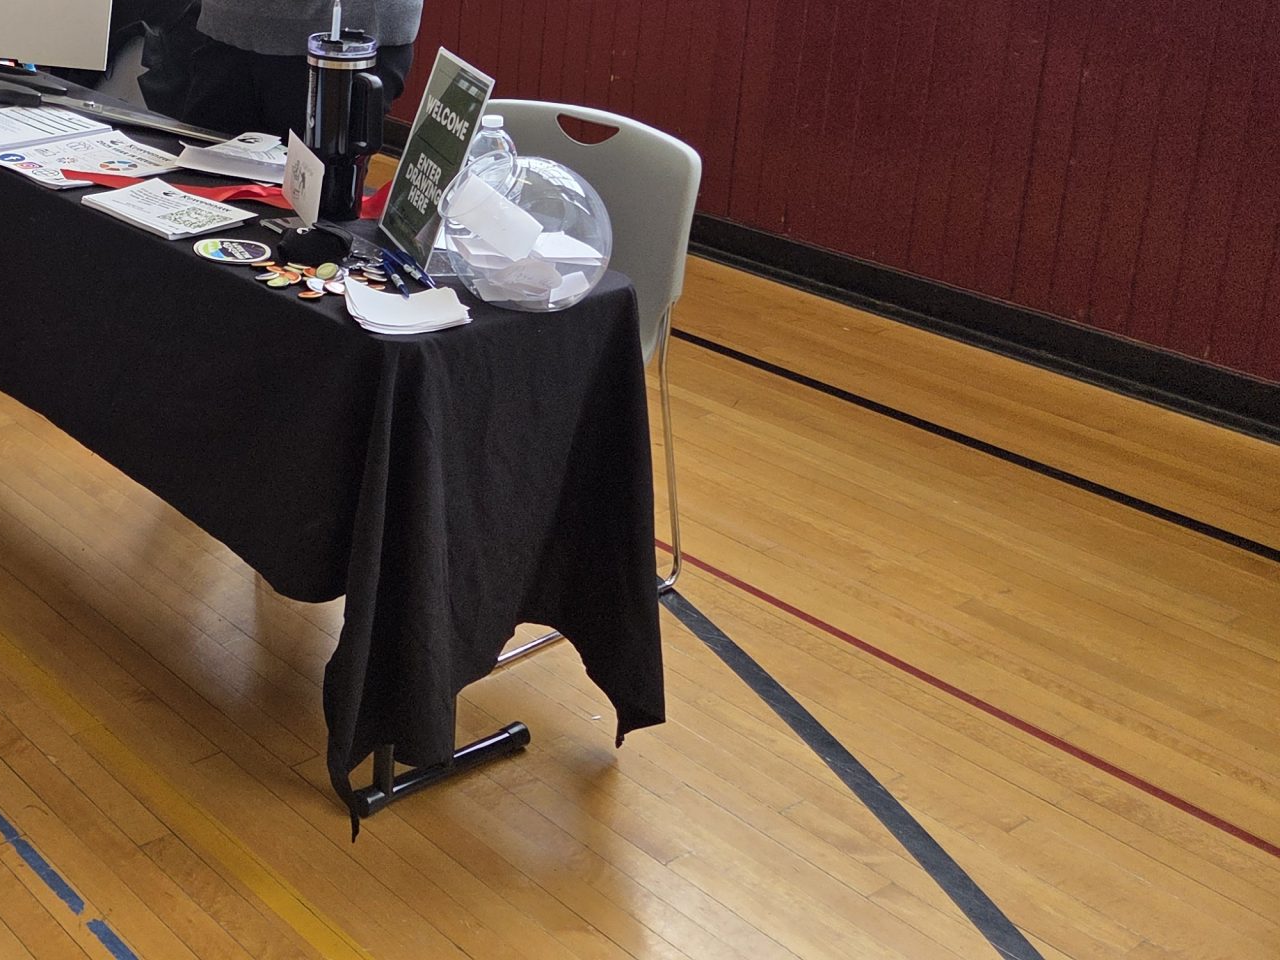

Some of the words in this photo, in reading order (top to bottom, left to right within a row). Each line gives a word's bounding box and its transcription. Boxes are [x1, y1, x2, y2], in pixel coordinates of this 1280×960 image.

[426, 94, 470, 141] WELCOME
[405, 162, 442, 206] DRAWING
[417, 152, 442, 185] ENTER
[408, 185, 429, 215] HERE
